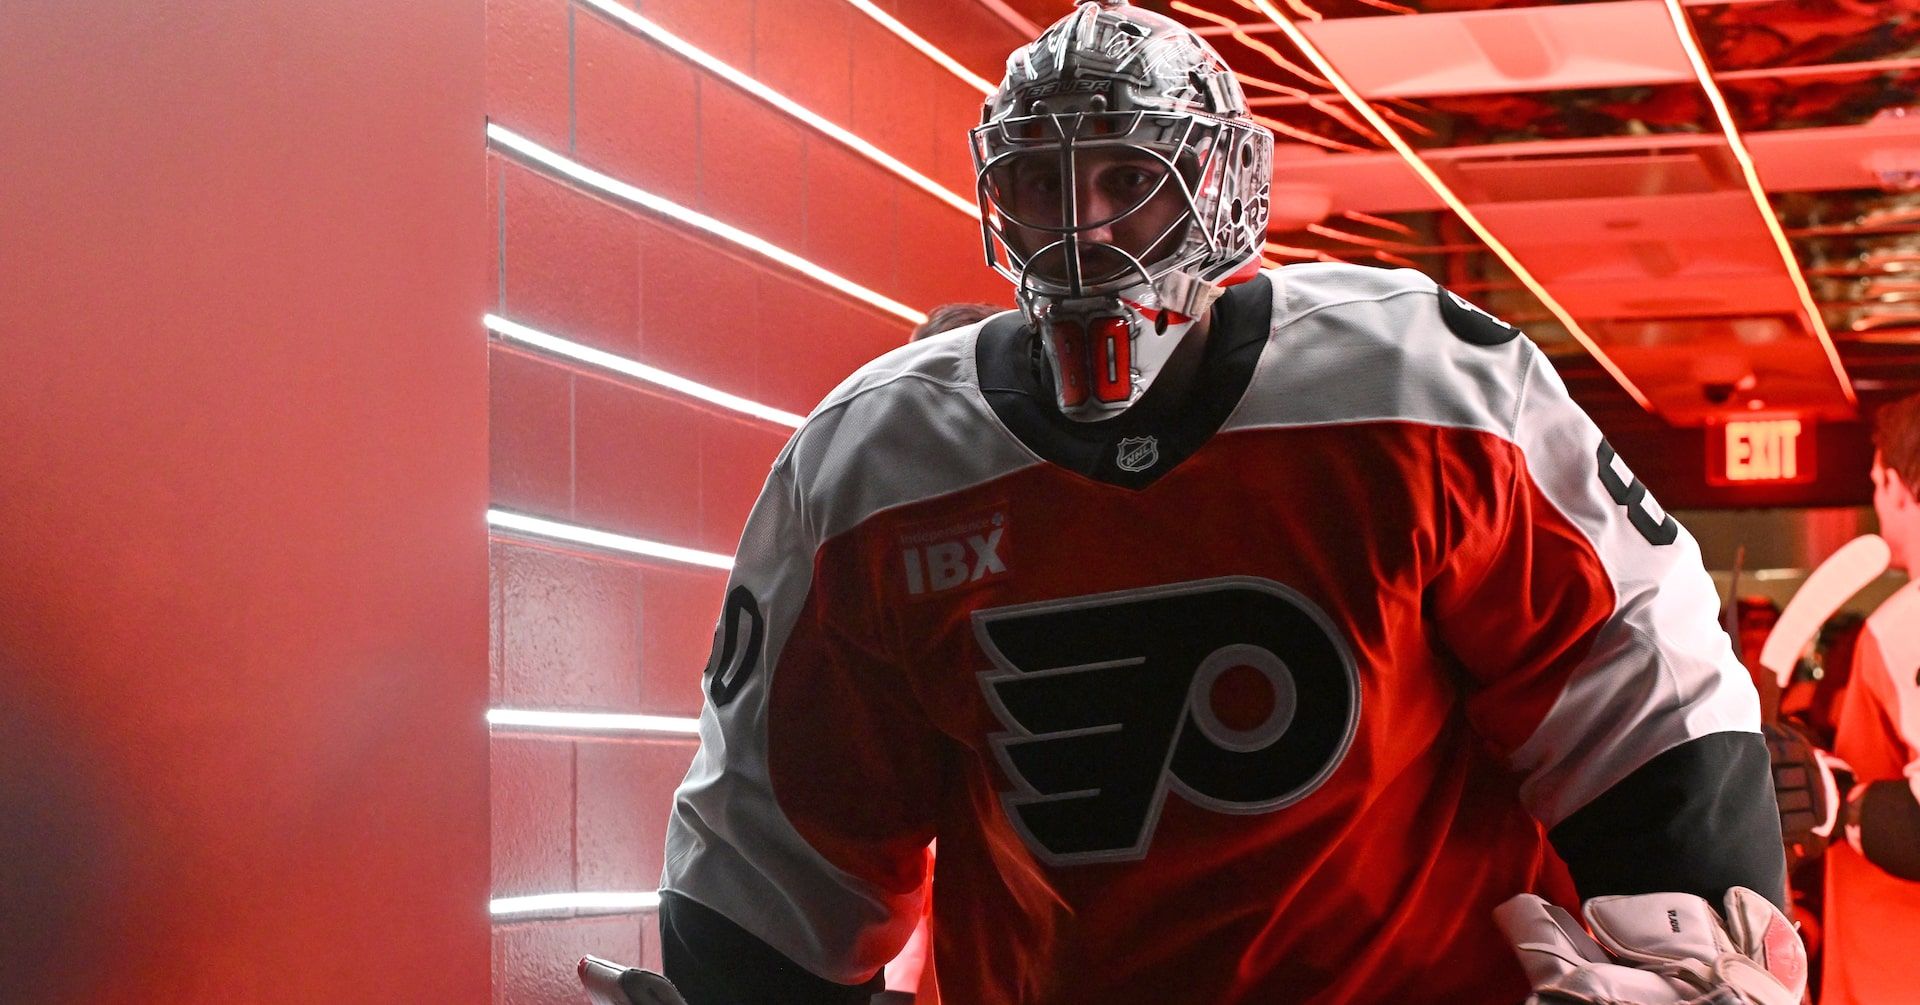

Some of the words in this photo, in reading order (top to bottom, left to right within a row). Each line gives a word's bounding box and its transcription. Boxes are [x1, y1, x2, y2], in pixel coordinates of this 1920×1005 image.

[1052, 315, 1131, 407] 80
[1126, 445, 1151, 466] NHL
[1725, 420, 1801, 480] EXIT
[903, 527, 1007, 594] IBX
[704, 584, 764, 708] 0
